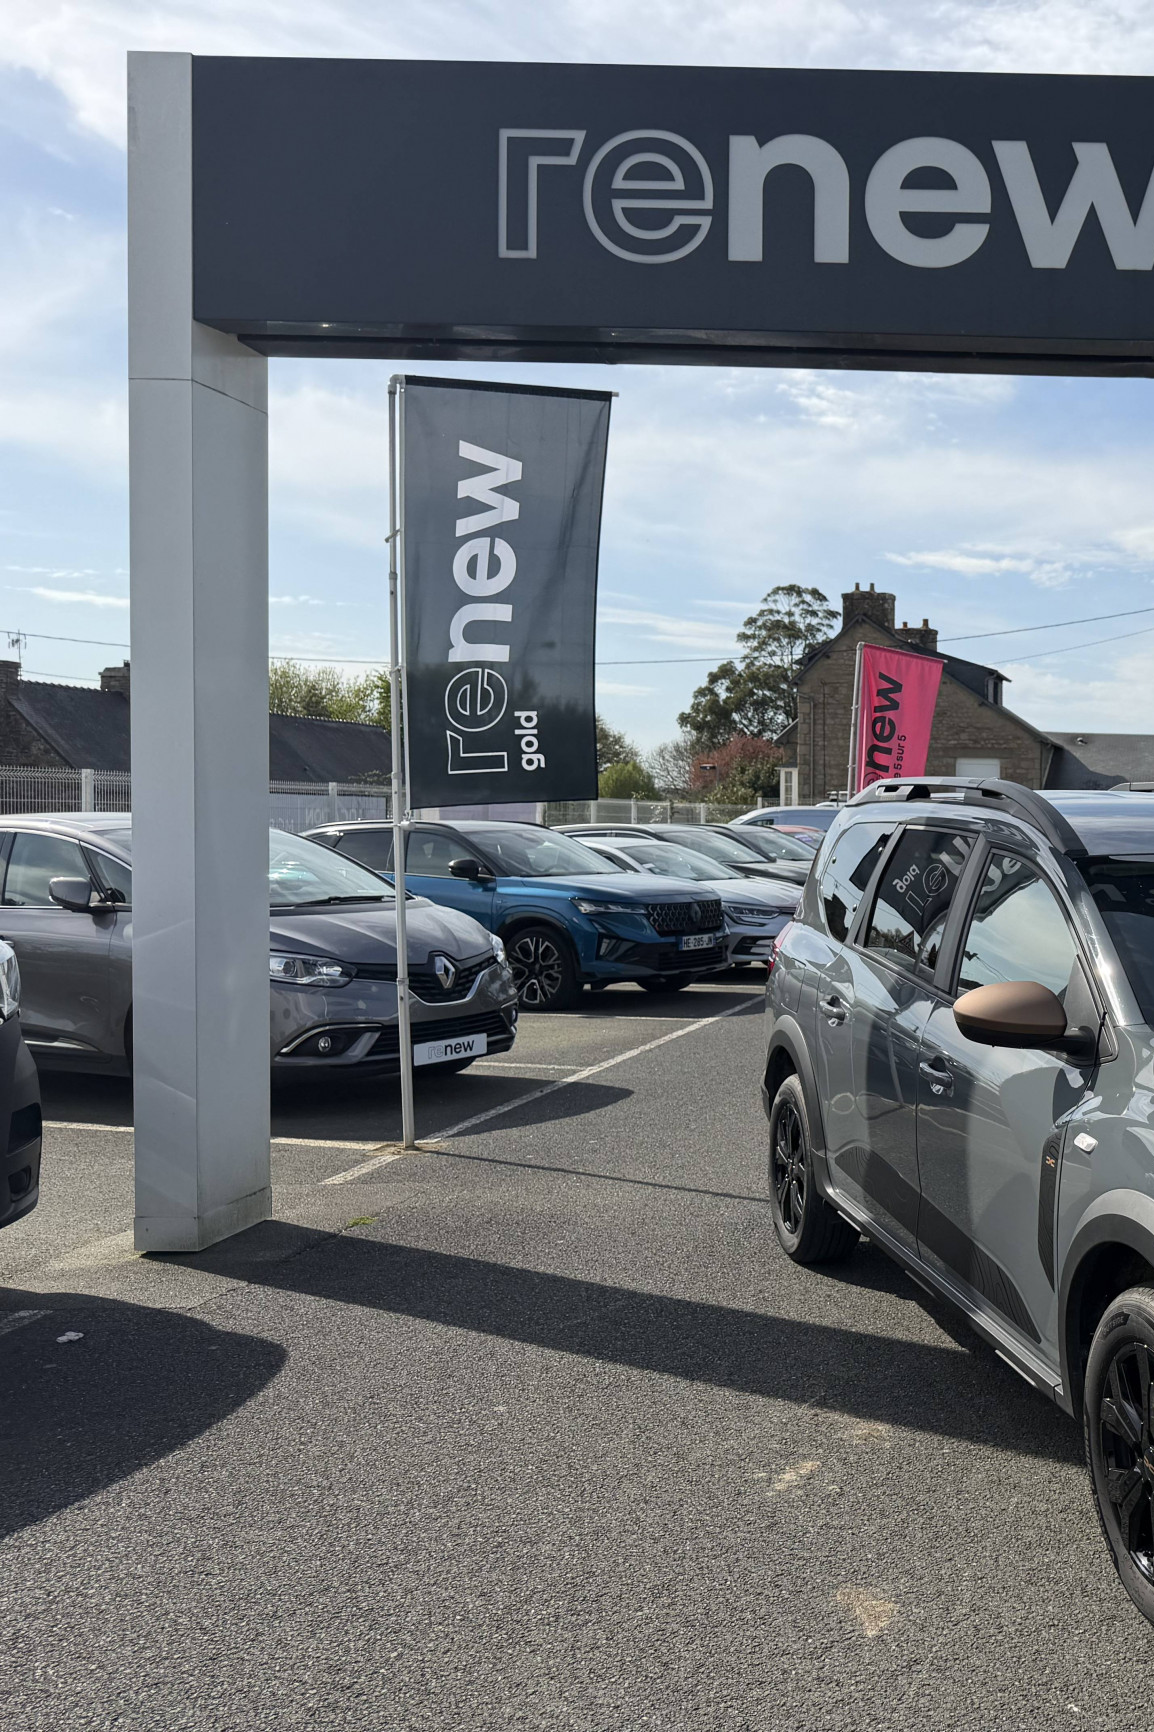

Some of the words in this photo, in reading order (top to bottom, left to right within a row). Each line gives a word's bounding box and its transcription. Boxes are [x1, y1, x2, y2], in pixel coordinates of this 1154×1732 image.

[445, 439, 523, 775] renew
[514, 710, 546, 771] gold
[897, 733, 907, 743] 5
[896, 743, 906, 762] sur
[893, 762, 903, 771] 5
[683, 935, 714, 949] HE-285-JN
[427, 1039, 475, 1060] renew
